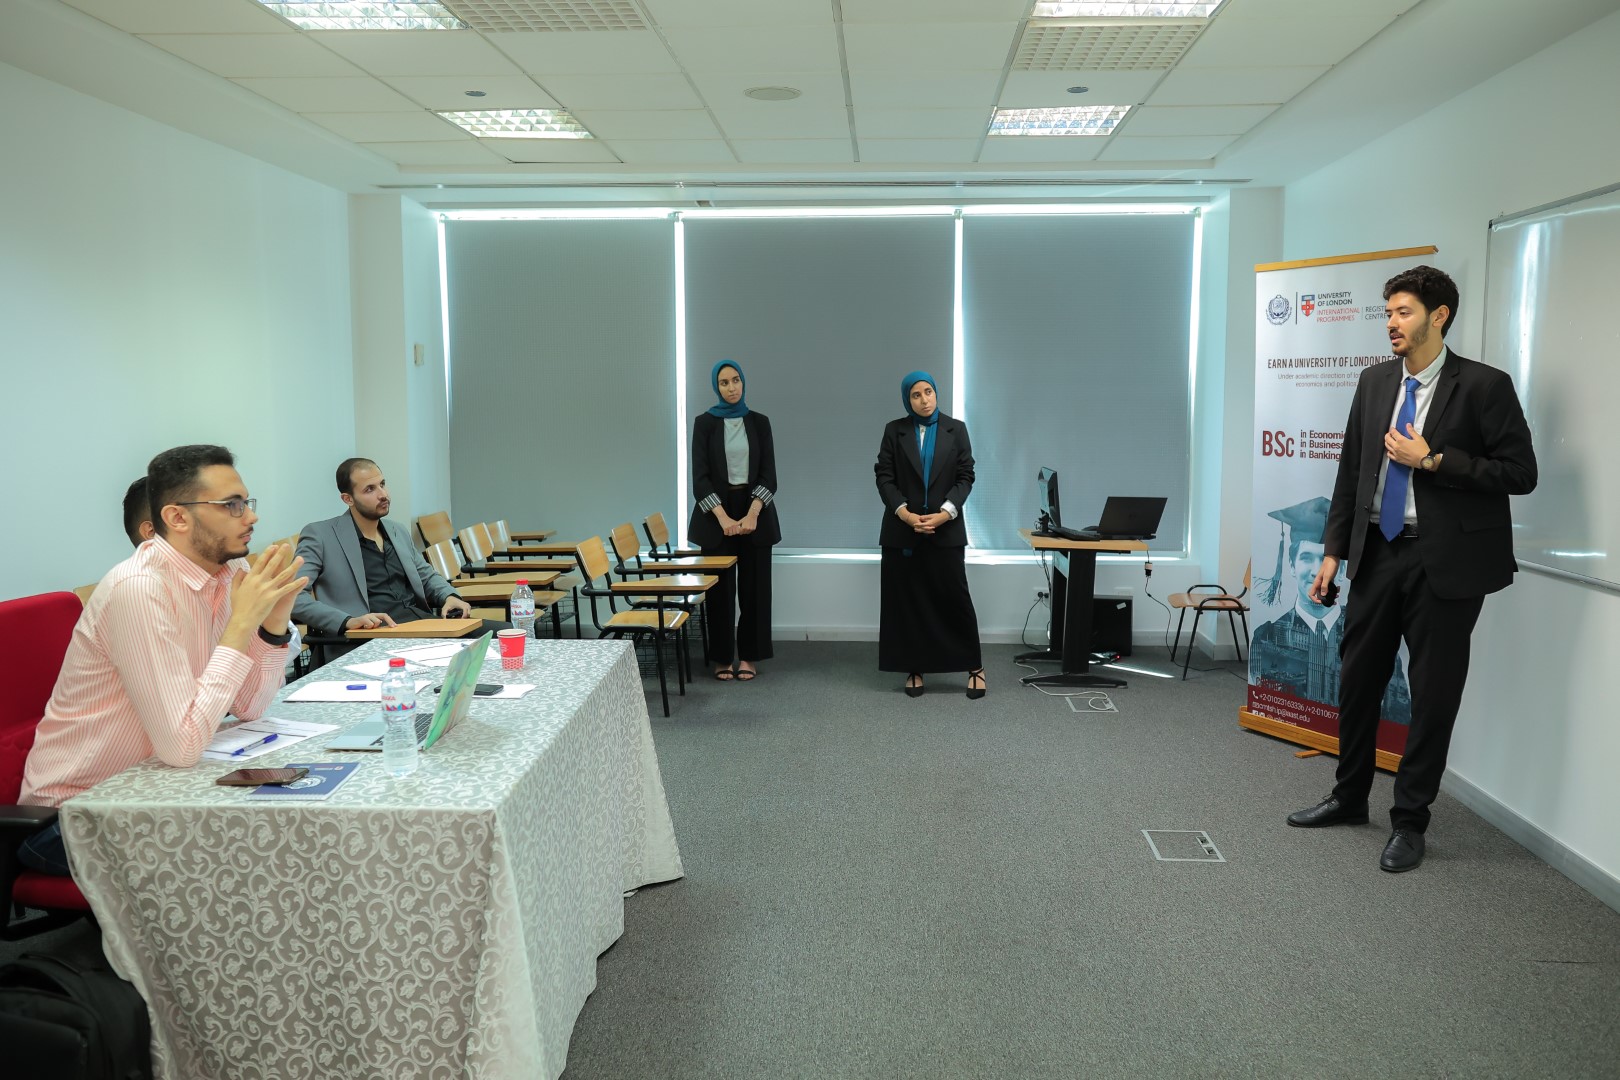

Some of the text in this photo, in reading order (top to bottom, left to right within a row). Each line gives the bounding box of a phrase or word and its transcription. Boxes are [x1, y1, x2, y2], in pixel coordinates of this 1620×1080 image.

[1318, 292, 1352, 300] UNIVERSITY
[1317, 307, 1360, 316] INTERNATIONAL
[1268, 358, 1287, 368] EARN
[1288, 358, 1293, 368] A
[1294, 357, 1337, 368] UNIVERSITY
[1339, 356, 1348, 367] OF
[1350, 356, 1380, 366] LONDON
[1300, 430, 1306, 438] in
[1262, 430, 1294, 457] BSc
[1300, 439, 1306, 448] in
[1300, 450, 1342, 462] in Banking
